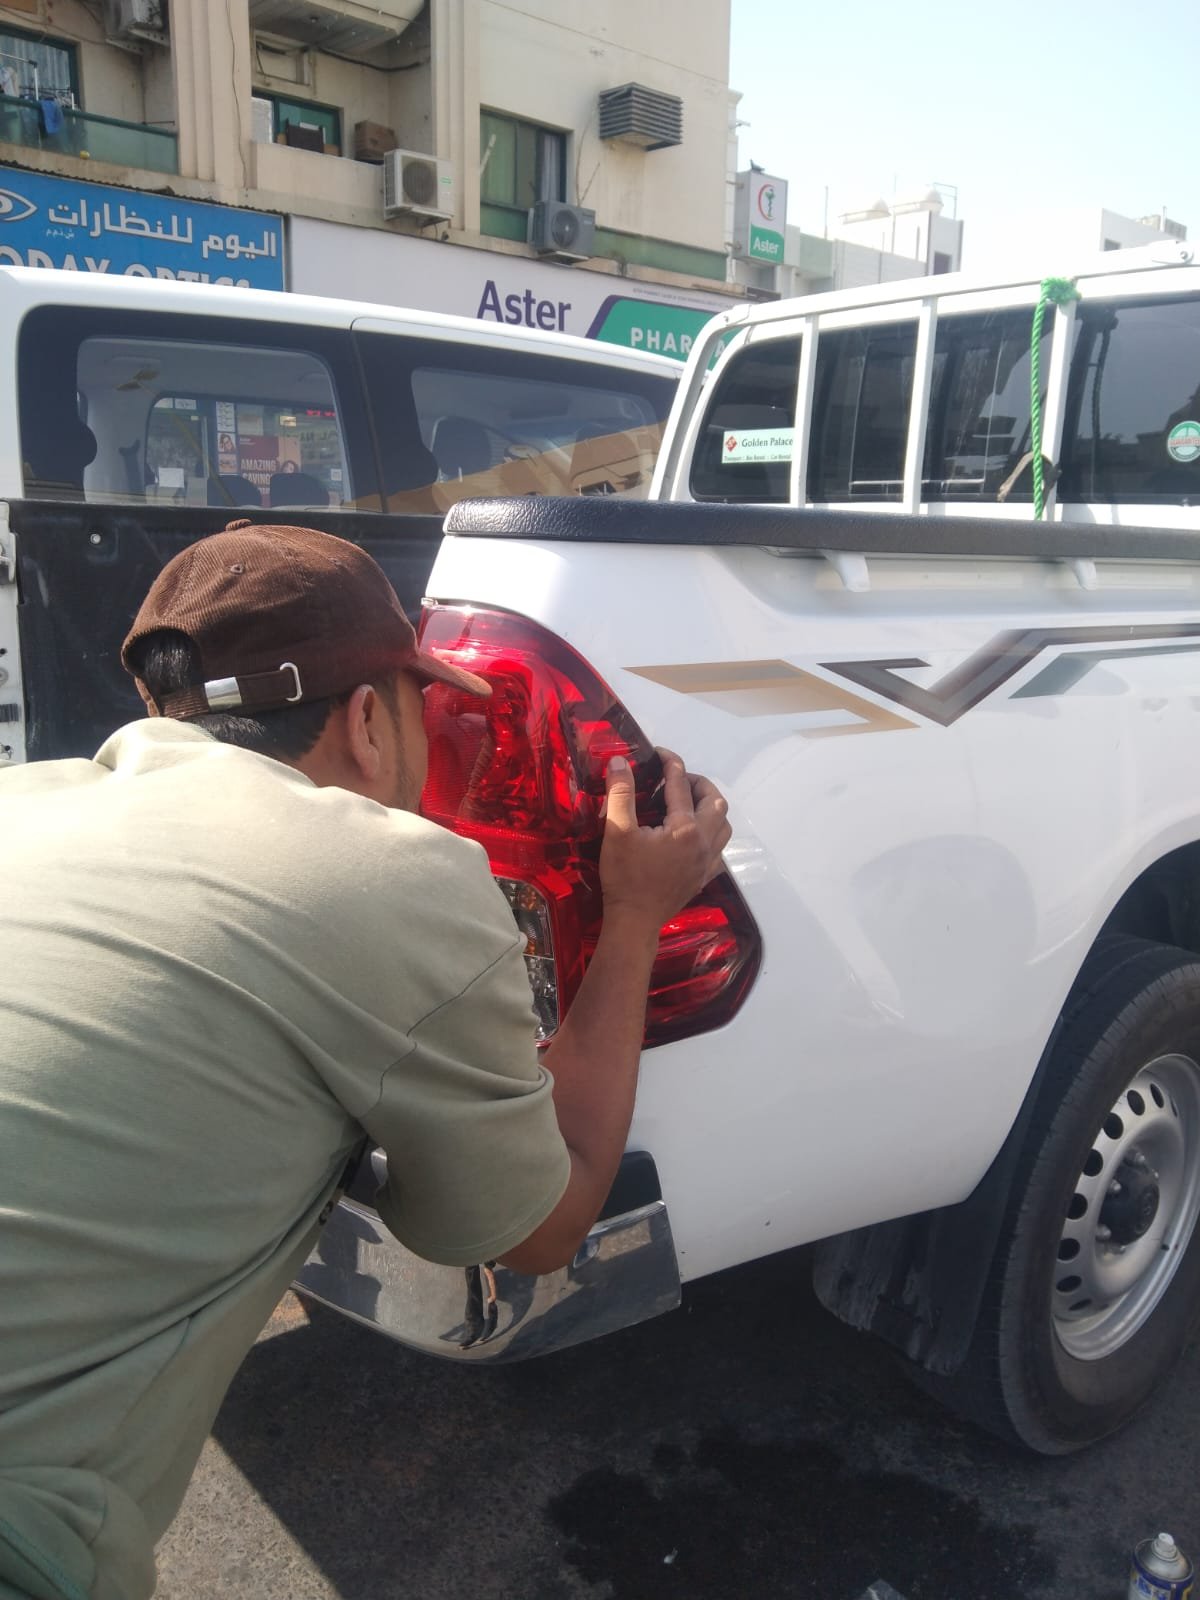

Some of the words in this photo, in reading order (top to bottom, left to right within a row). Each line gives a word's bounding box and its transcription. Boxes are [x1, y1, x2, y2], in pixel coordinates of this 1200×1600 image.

[48, 199, 193, 244] للنظارات
[202, 231, 276, 259] اليوم
[753, 236, 780, 255] Aster
[477, 280, 571, 331] Aster
[741, 438, 768, 448] Golden
[770, 437, 793, 447] Palace
[240, 458, 277, 472] AMAZING
[242, 472, 272, 486] AVING
